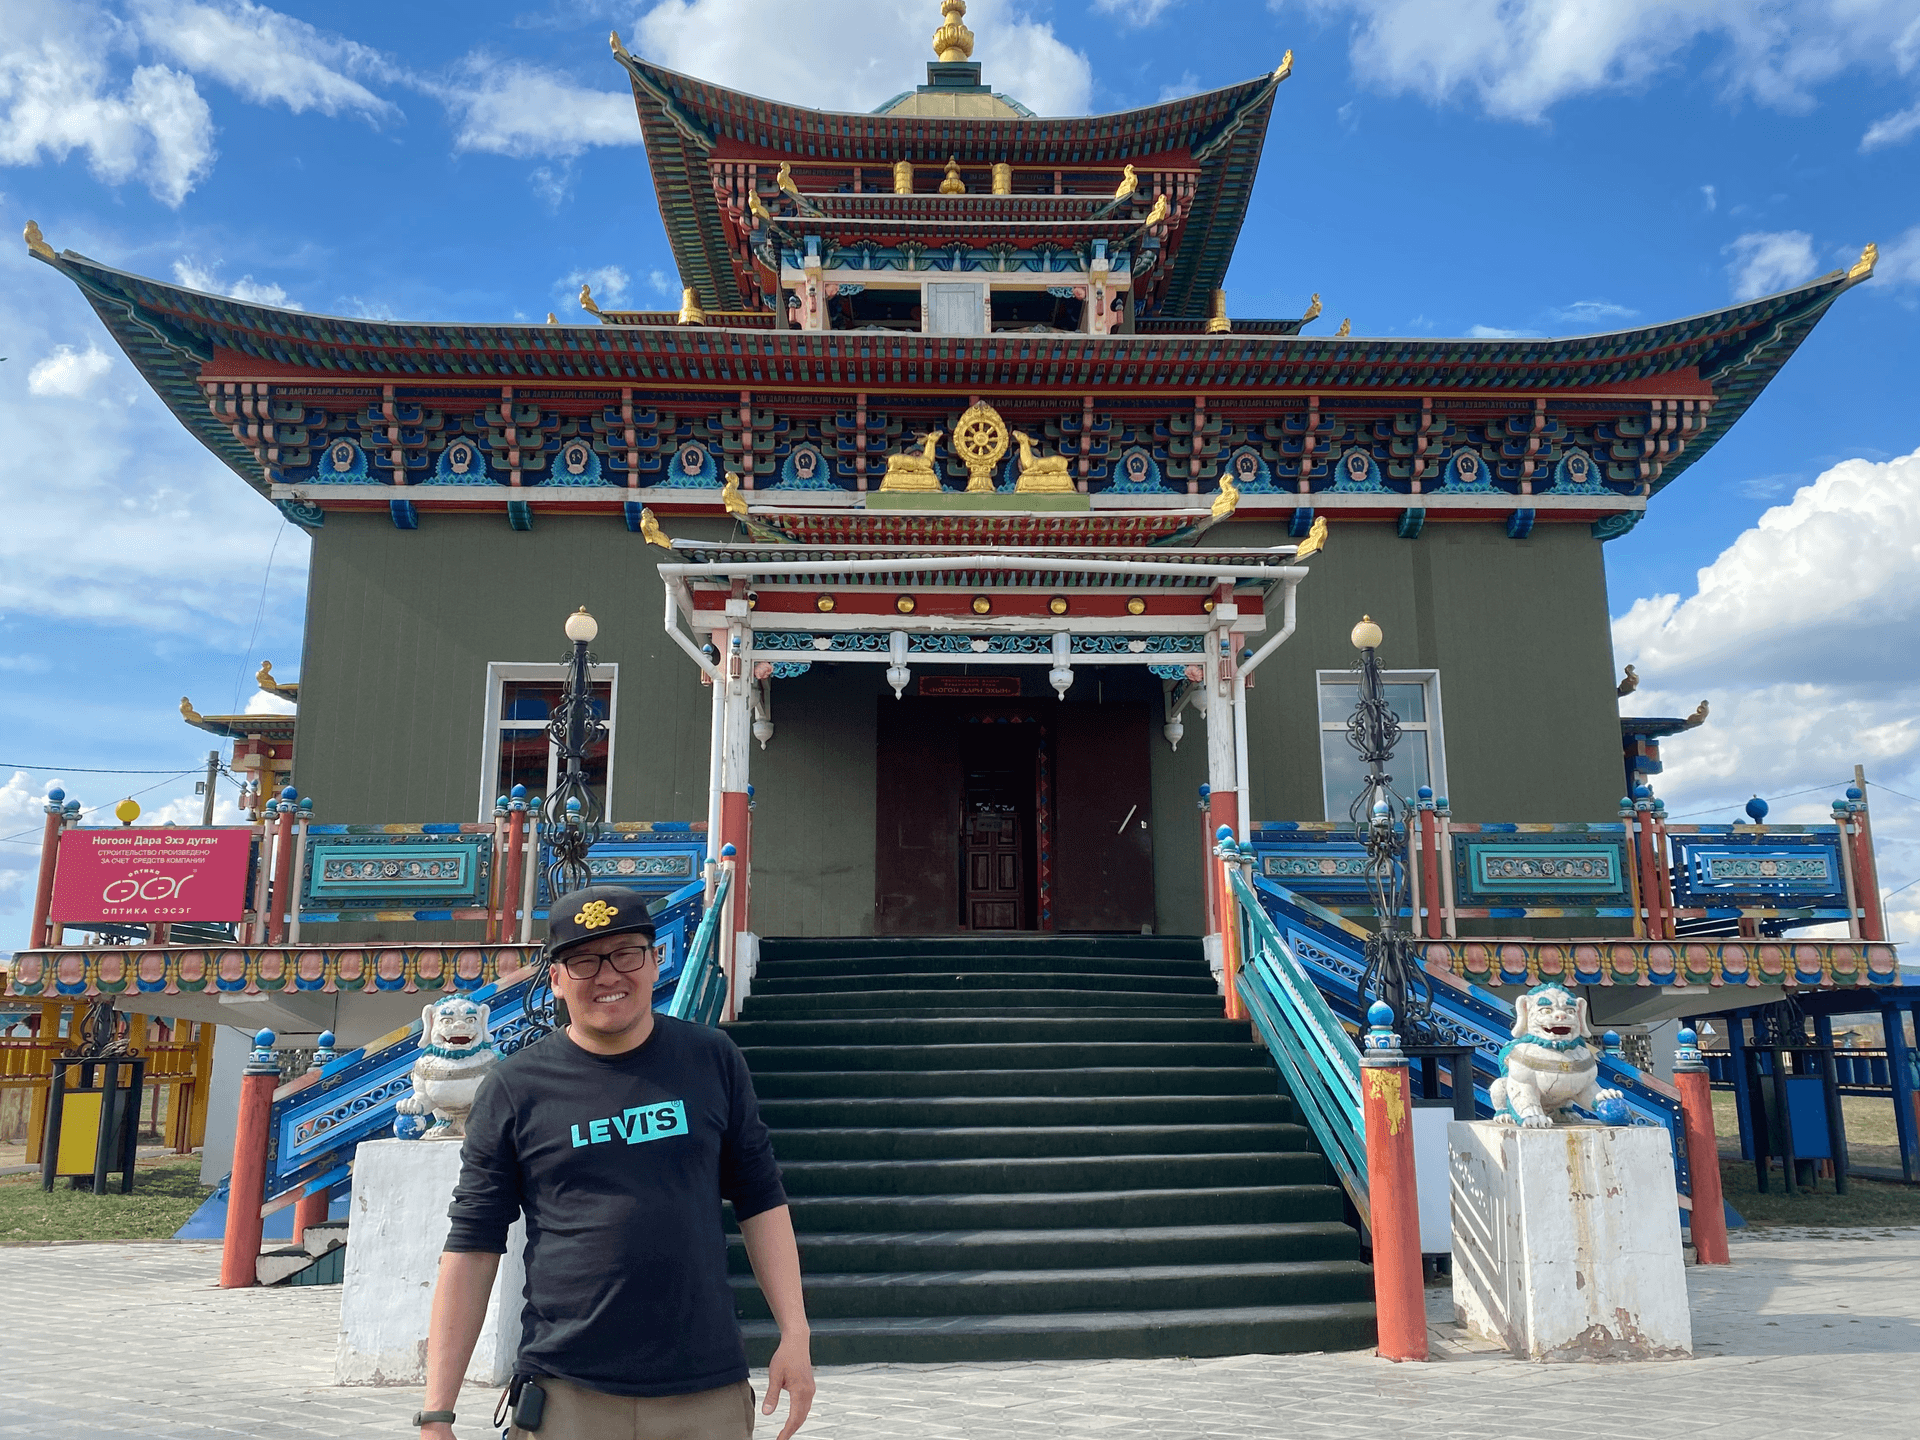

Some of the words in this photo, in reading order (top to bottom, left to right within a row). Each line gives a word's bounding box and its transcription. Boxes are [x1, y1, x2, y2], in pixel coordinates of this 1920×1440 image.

[92, 836, 132, 845] Ногоон
[134, 836, 162, 846] Дара
[164, 836, 184, 845] Эхэ
[187, 837, 218, 847] дуган
